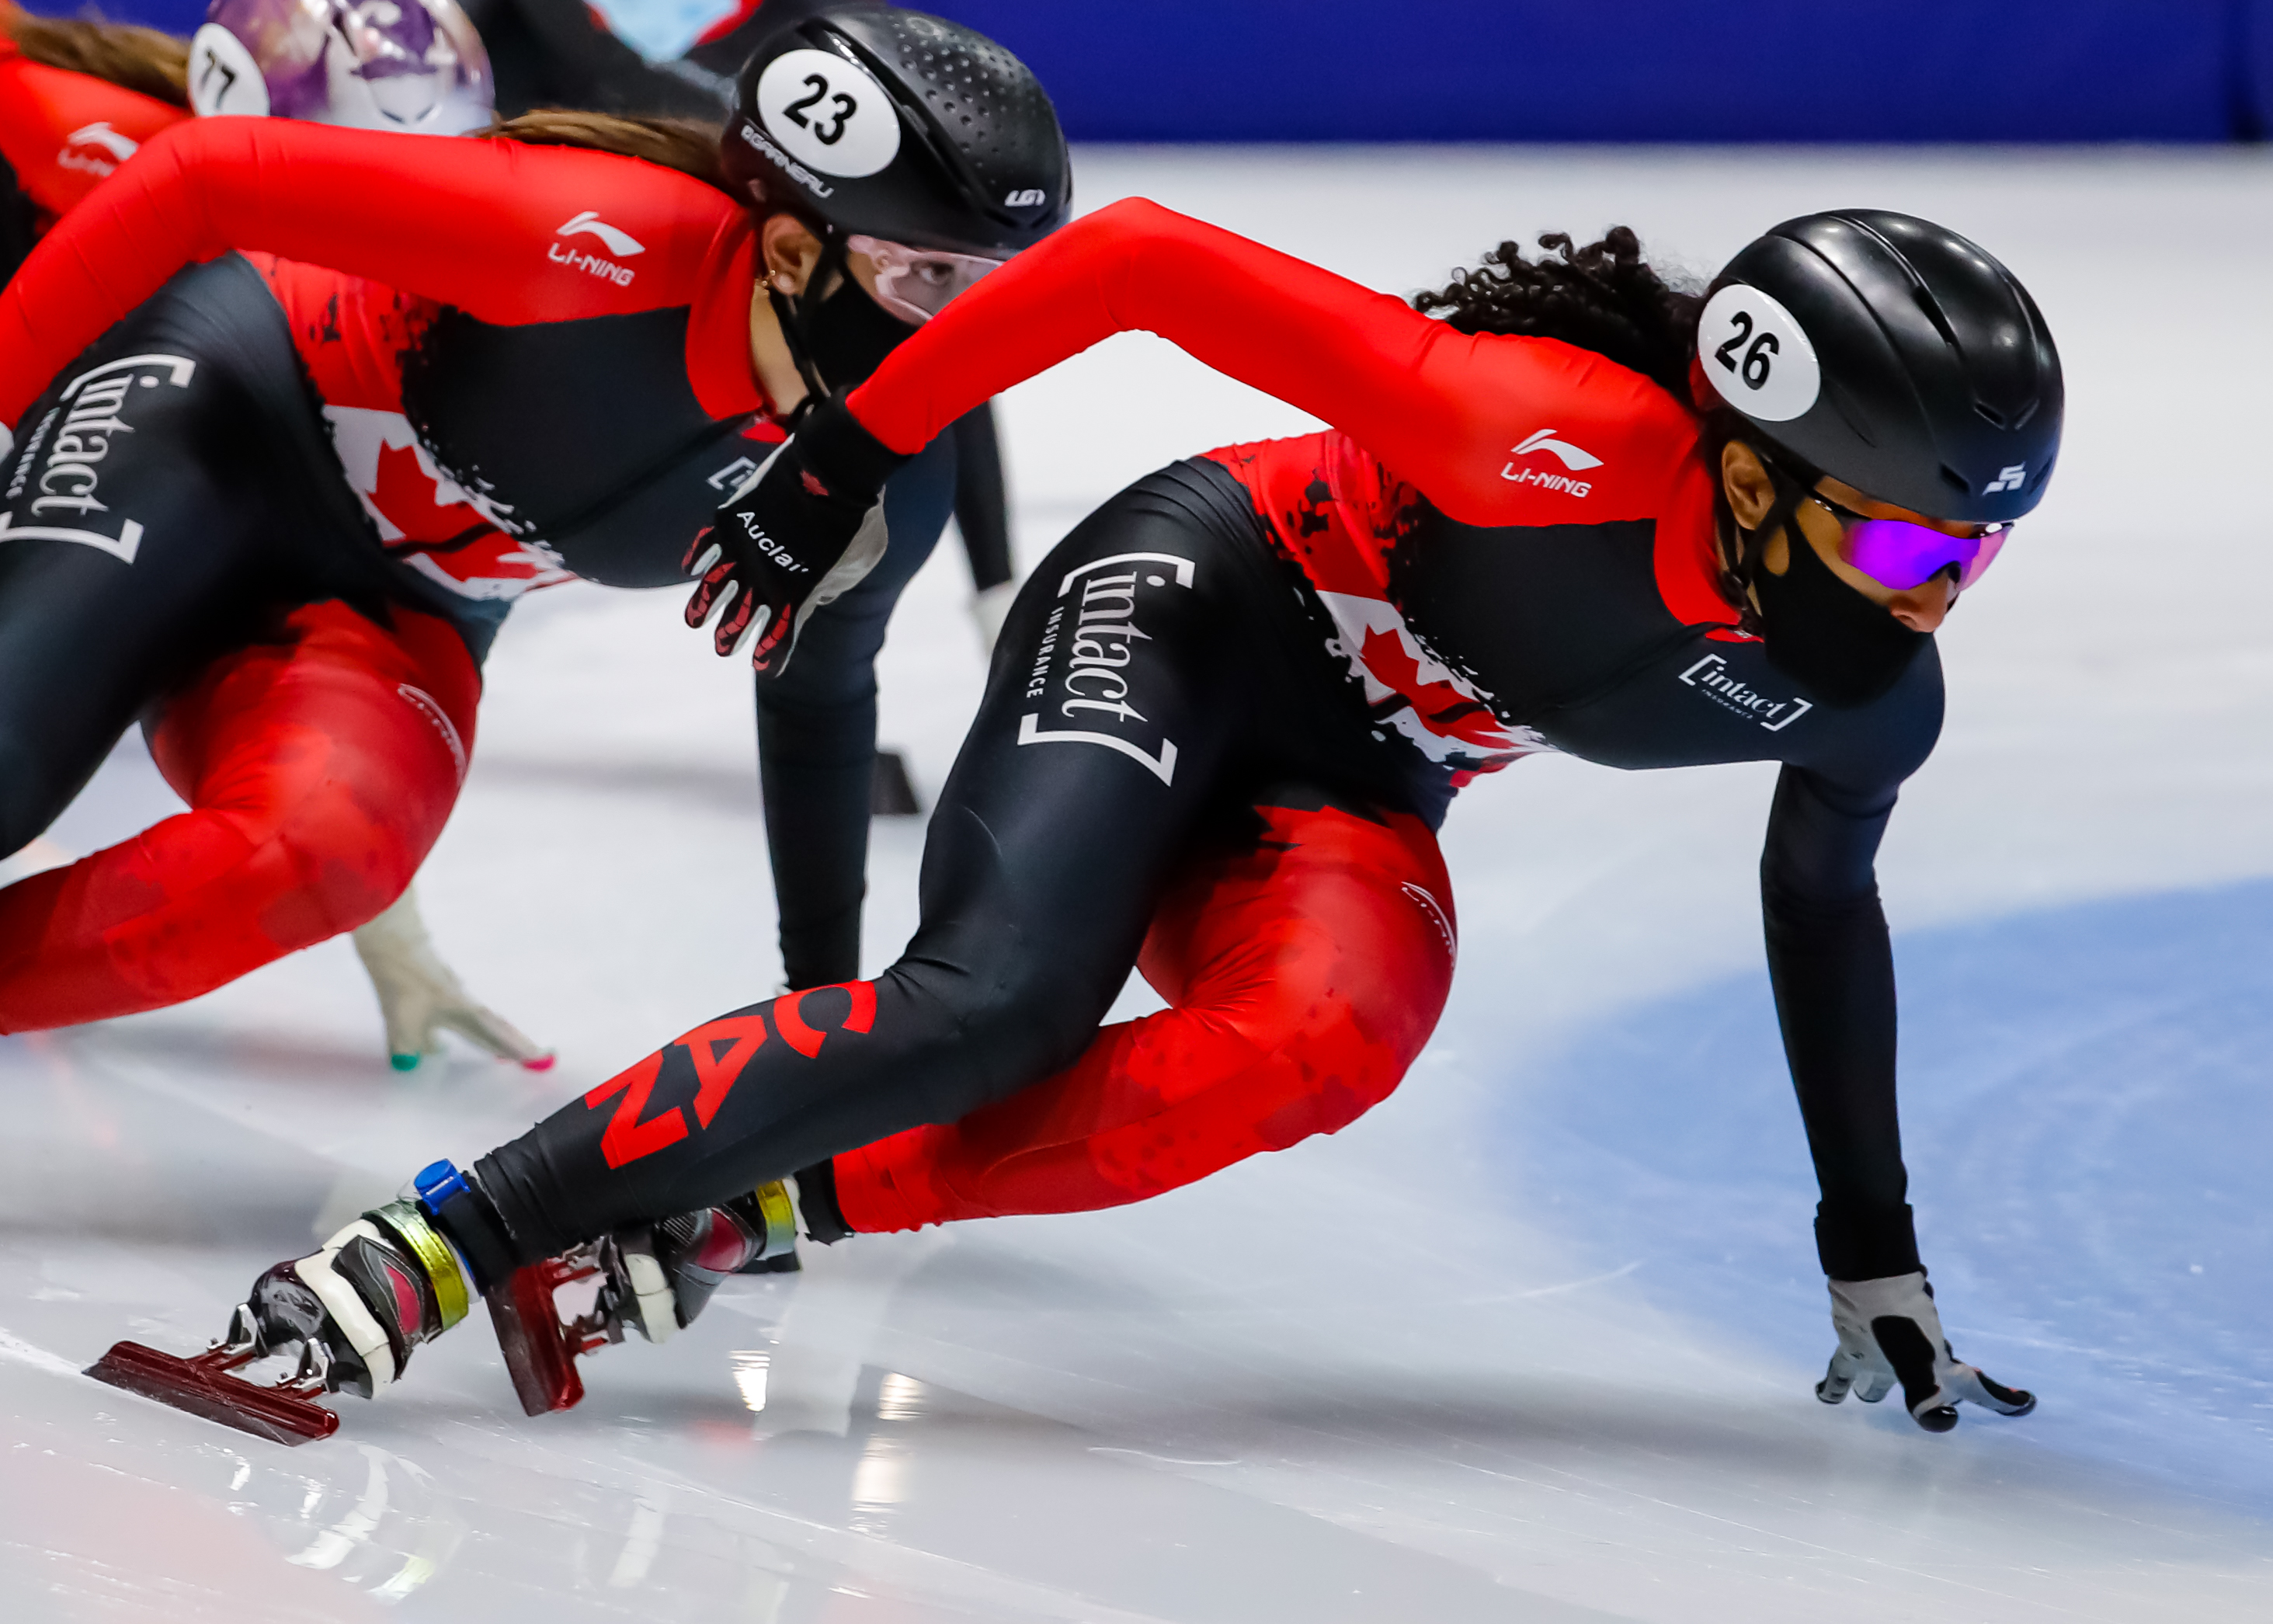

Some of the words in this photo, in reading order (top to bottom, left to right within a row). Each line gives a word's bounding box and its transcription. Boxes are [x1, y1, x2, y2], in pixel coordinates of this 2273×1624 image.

[781, 74, 857, 146] 23
[547, 242, 635, 287] LI-NING
[1714, 310, 1780, 391] 26
[1500, 461, 1593, 499] LI-NING
[1026, 606, 1065, 699] INSURANCE
[584, 978, 878, 1170] CAN
